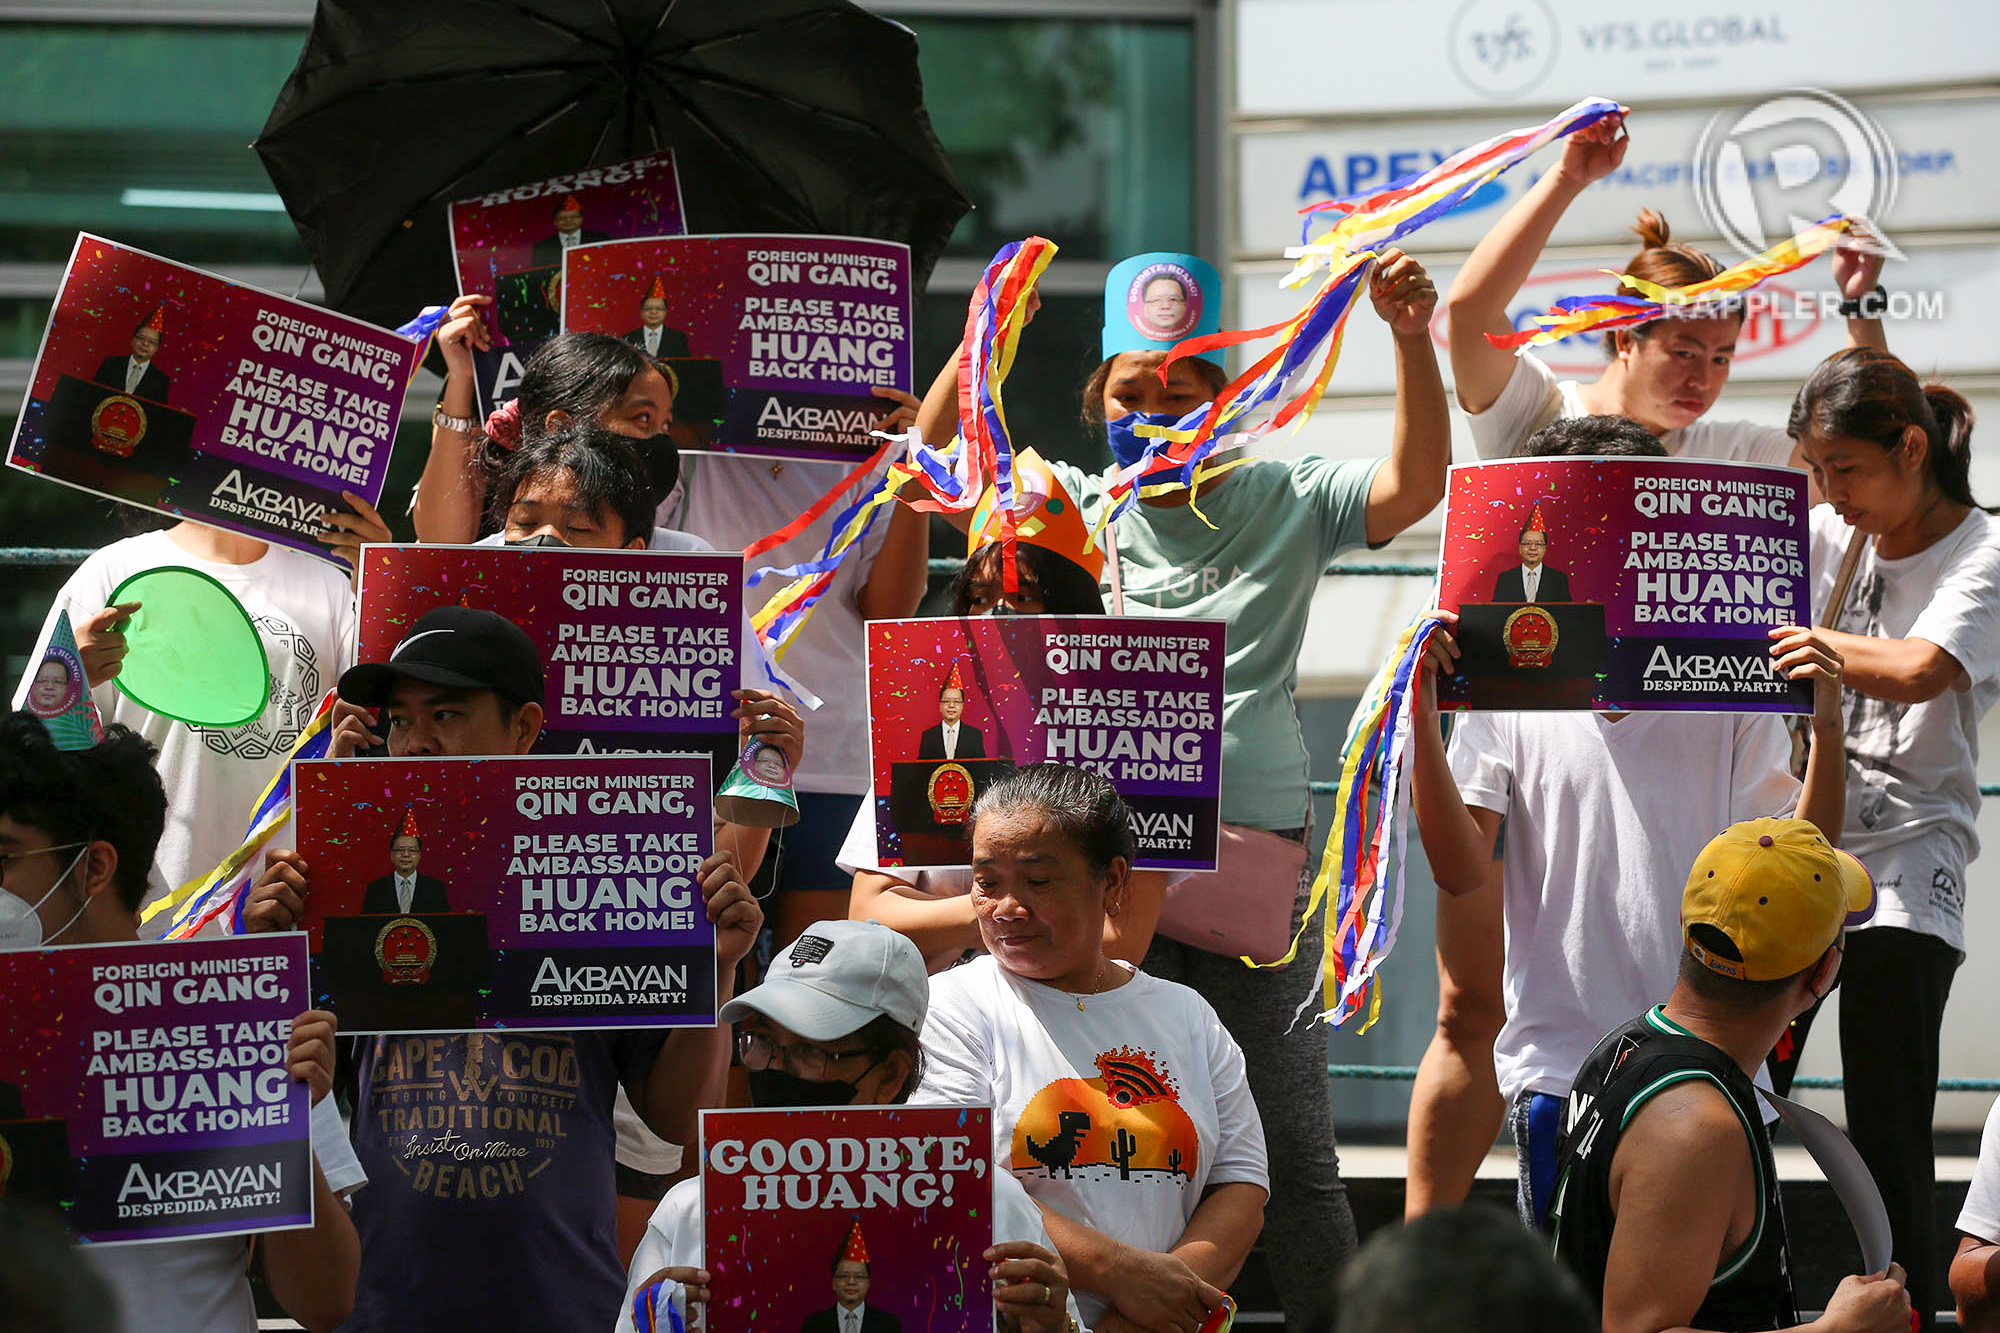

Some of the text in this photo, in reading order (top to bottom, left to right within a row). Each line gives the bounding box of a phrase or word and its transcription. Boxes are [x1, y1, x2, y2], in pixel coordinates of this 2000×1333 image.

[1576, 15, 1791, 50] VFS.GLOBAL
[1299, 151, 1467, 199] APE
[747, 250, 897, 270] FOREIGN MINISTER
[748, 263, 897, 295] QIN GANG,
[745, 297, 900, 322] PLEASE TAKE
[256, 309, 401, 366] FOREIGN MINISTER
[739, 315, 905, 340] AMBASSADOR
[252, 324, 395, 392] QIN GANG,
[751, 333, 894, 367] HUANG
[749, 361, 896, 385] BACK HOME!
[237, 358, 391, 420] PLEASE TAKE
[225, 377, 390, 441] AMBASSADOR
[228, 398, 375, 466] HUANG
[757, 427, 834, 443] DESPEDIDA
[220, 426, 370, 486] BACK HOME!
[212, 469, 345, 533] AKBAYA
[1634, 477, 1795, 499] FOREIGN MINISTER
[209, 496, 288, 528] DESPEDIDA
[1634, 492, 1796, 526] QIN GANG,
[1631, 531, 1799, 557] PLEASE TAKE
[562, 569, 729, 586] FOREIGN MINISTER
[1623, 552, 1804, 578] AMBASSADOR
[562, 584, 728, 614] QIN GANG,
[1637, 572, 1794, 606] HUANG
[1634, 605, 1796, 626] BACK HOME!
[558, 624, 729, 646] PLEASE TAKE
[1046, 634, 1210, 651] FOREIGN MINISTER
[551, 644, 734, 665] AMBASSADOR
[1046, 648, 1209, 679] QIN GANG,
[563, 665, 721, 698] HUANG
[1643, 680, 1788, 692] DESPEDIDA PARTY!
[560, 697, 723, 718] BACK HOME!
[1042, 688, 1210, 710] PLEASE TAKE
[1034, 708, 1215, 730] AMBASSADOR
[1046, 728, 1202, 762] HUANG
[515, 775, 695, 790] FOREIGN MINISTER
[1044, 760, 1203, 782] CK HOME!
[516, 790, 695, 820] QIN GANG,
[1127, 813, 1193, 837] AYAN
[514, 833, 698, 854] PLEASE TAKE
[1137, 837, 1191, 850] PARTY!
[506, 855, 704, 876] AMBASSADOR
[522, 876, 692, 911] HUANG
[519, 911, 695, 932] BACK HOME!
[92, 956, 289, 982] FOREIGN MINISTER
[530, 957, 687, 993] AKBAYAN
[94, 974, 290, 1014] QIN GANG,
[531, 992, 687, 1006] DESPEDIDA PARTY!
[93, 1019, 294, 1052] PLEASE TAKE
[503, 1041, 581, 1087] COD
[104, 1068, 289, 1114] HUANG
[496, 1092, 576, 1110] YOURSELF
[102, 1104, 290, 1138] BACK HOME!
[377, 1105, 567, 1137] TRADITIONAL
[404, 1130, 529, 1161] Insist On Mine
[710, 1136, 986, 1179] GOODBYE,
[117, 1162, 282, 1202] AKBAYAN
[413, 1158, 525, 1200] BEACH
[742, 1173, 954, 1210] HUANG!
[118, 1192, 281, 1218] DESPEDIDA PARTY!
